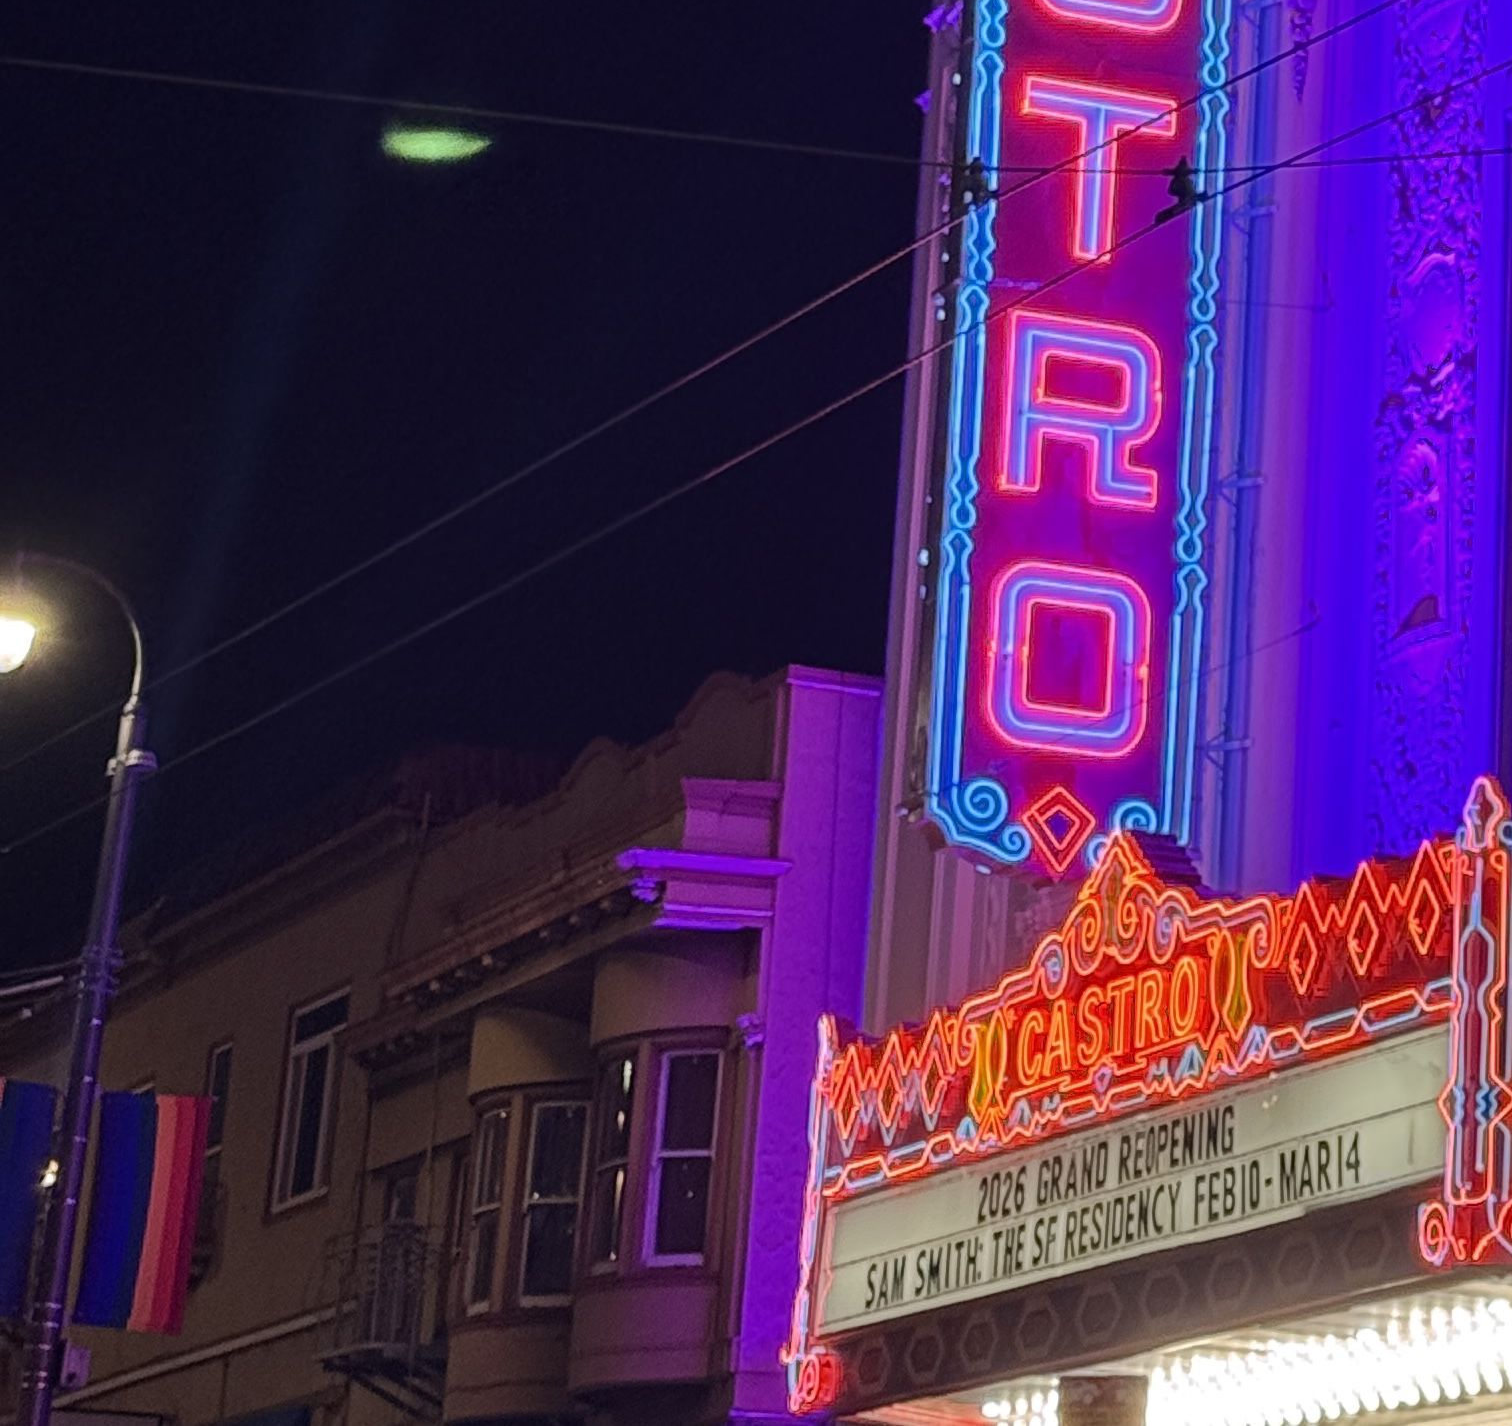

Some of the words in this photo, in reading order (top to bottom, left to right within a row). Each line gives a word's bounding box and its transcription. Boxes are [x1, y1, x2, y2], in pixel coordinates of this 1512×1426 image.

[1016, 956, 1200, 1087] CASTRO
[977, 1164, 1026, 1225] 2026
[1036, 1140, 1108, 1207] GRAND
[1118, 1104, 1235, 1185] REOPENING
[865, 1254, 907, 1309] SAM
[914, 1235, 984, 1298] SMITH:
[992, 1223, 1026, 1279] THE
[1031, 1214, 1058, 1268] SF
[1063, 1180, 1182, 1261] RESIDENCY
